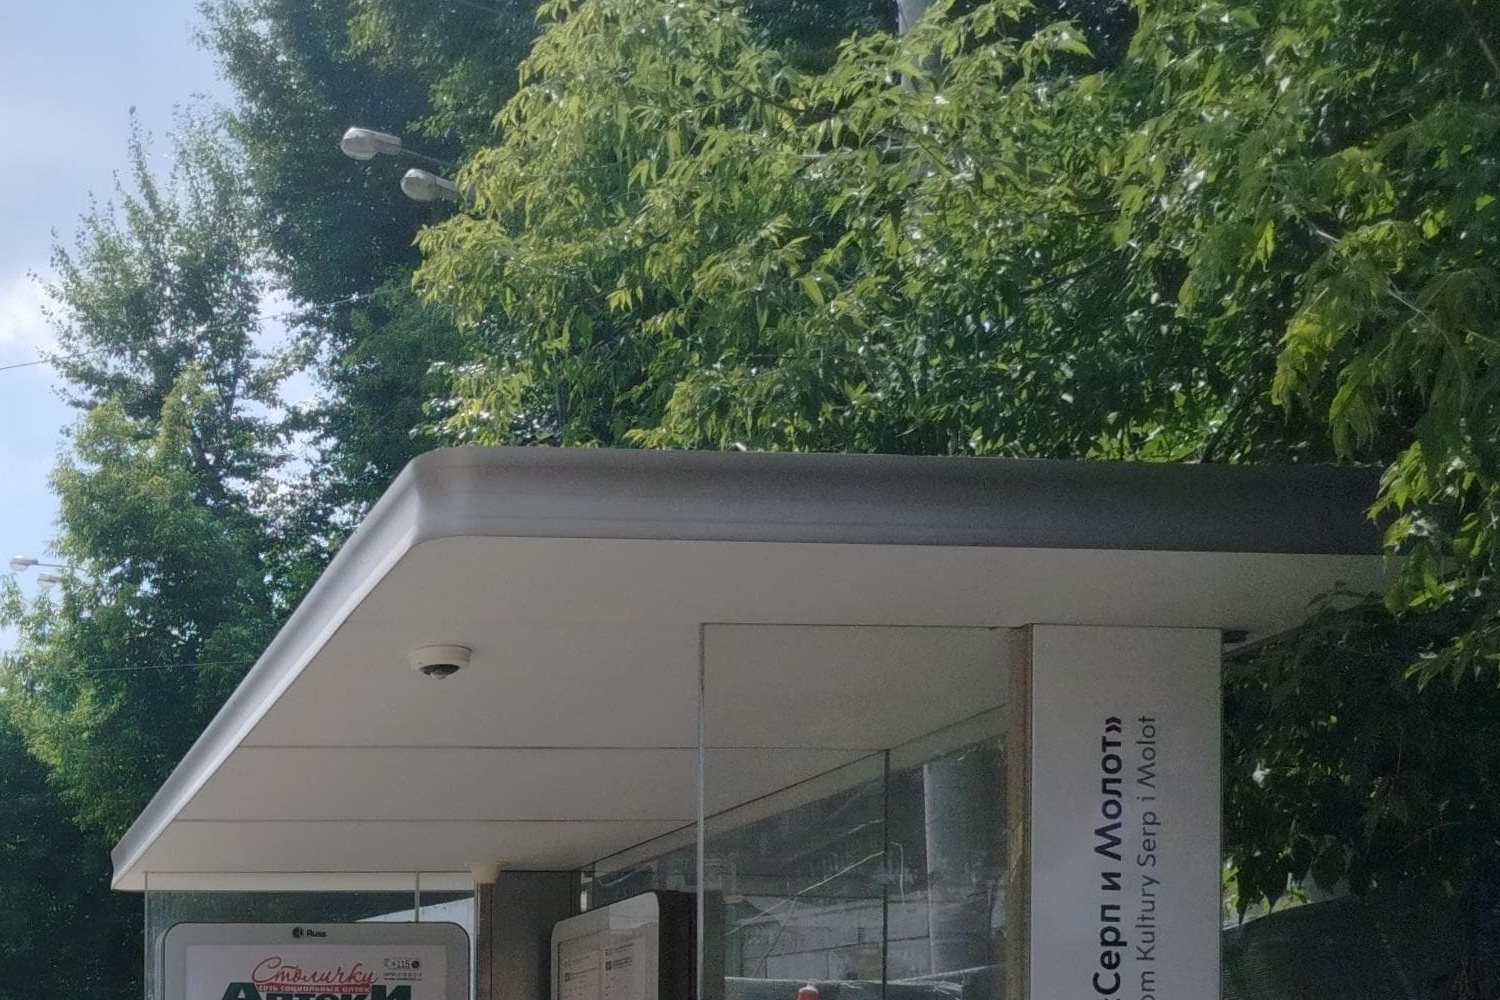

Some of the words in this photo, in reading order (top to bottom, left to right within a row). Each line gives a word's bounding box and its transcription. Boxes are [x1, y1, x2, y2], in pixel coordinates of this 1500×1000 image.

[1136, 715, 1156, 788] Molot
[1094, 717, 1122, 861] Молот»
[1137, 812, 1161, 867] Serp
[1100, 872, 1122, 891] и
[1136, 875, 1161, 960] Kultury
[252, 956, 378, 984] Столички
